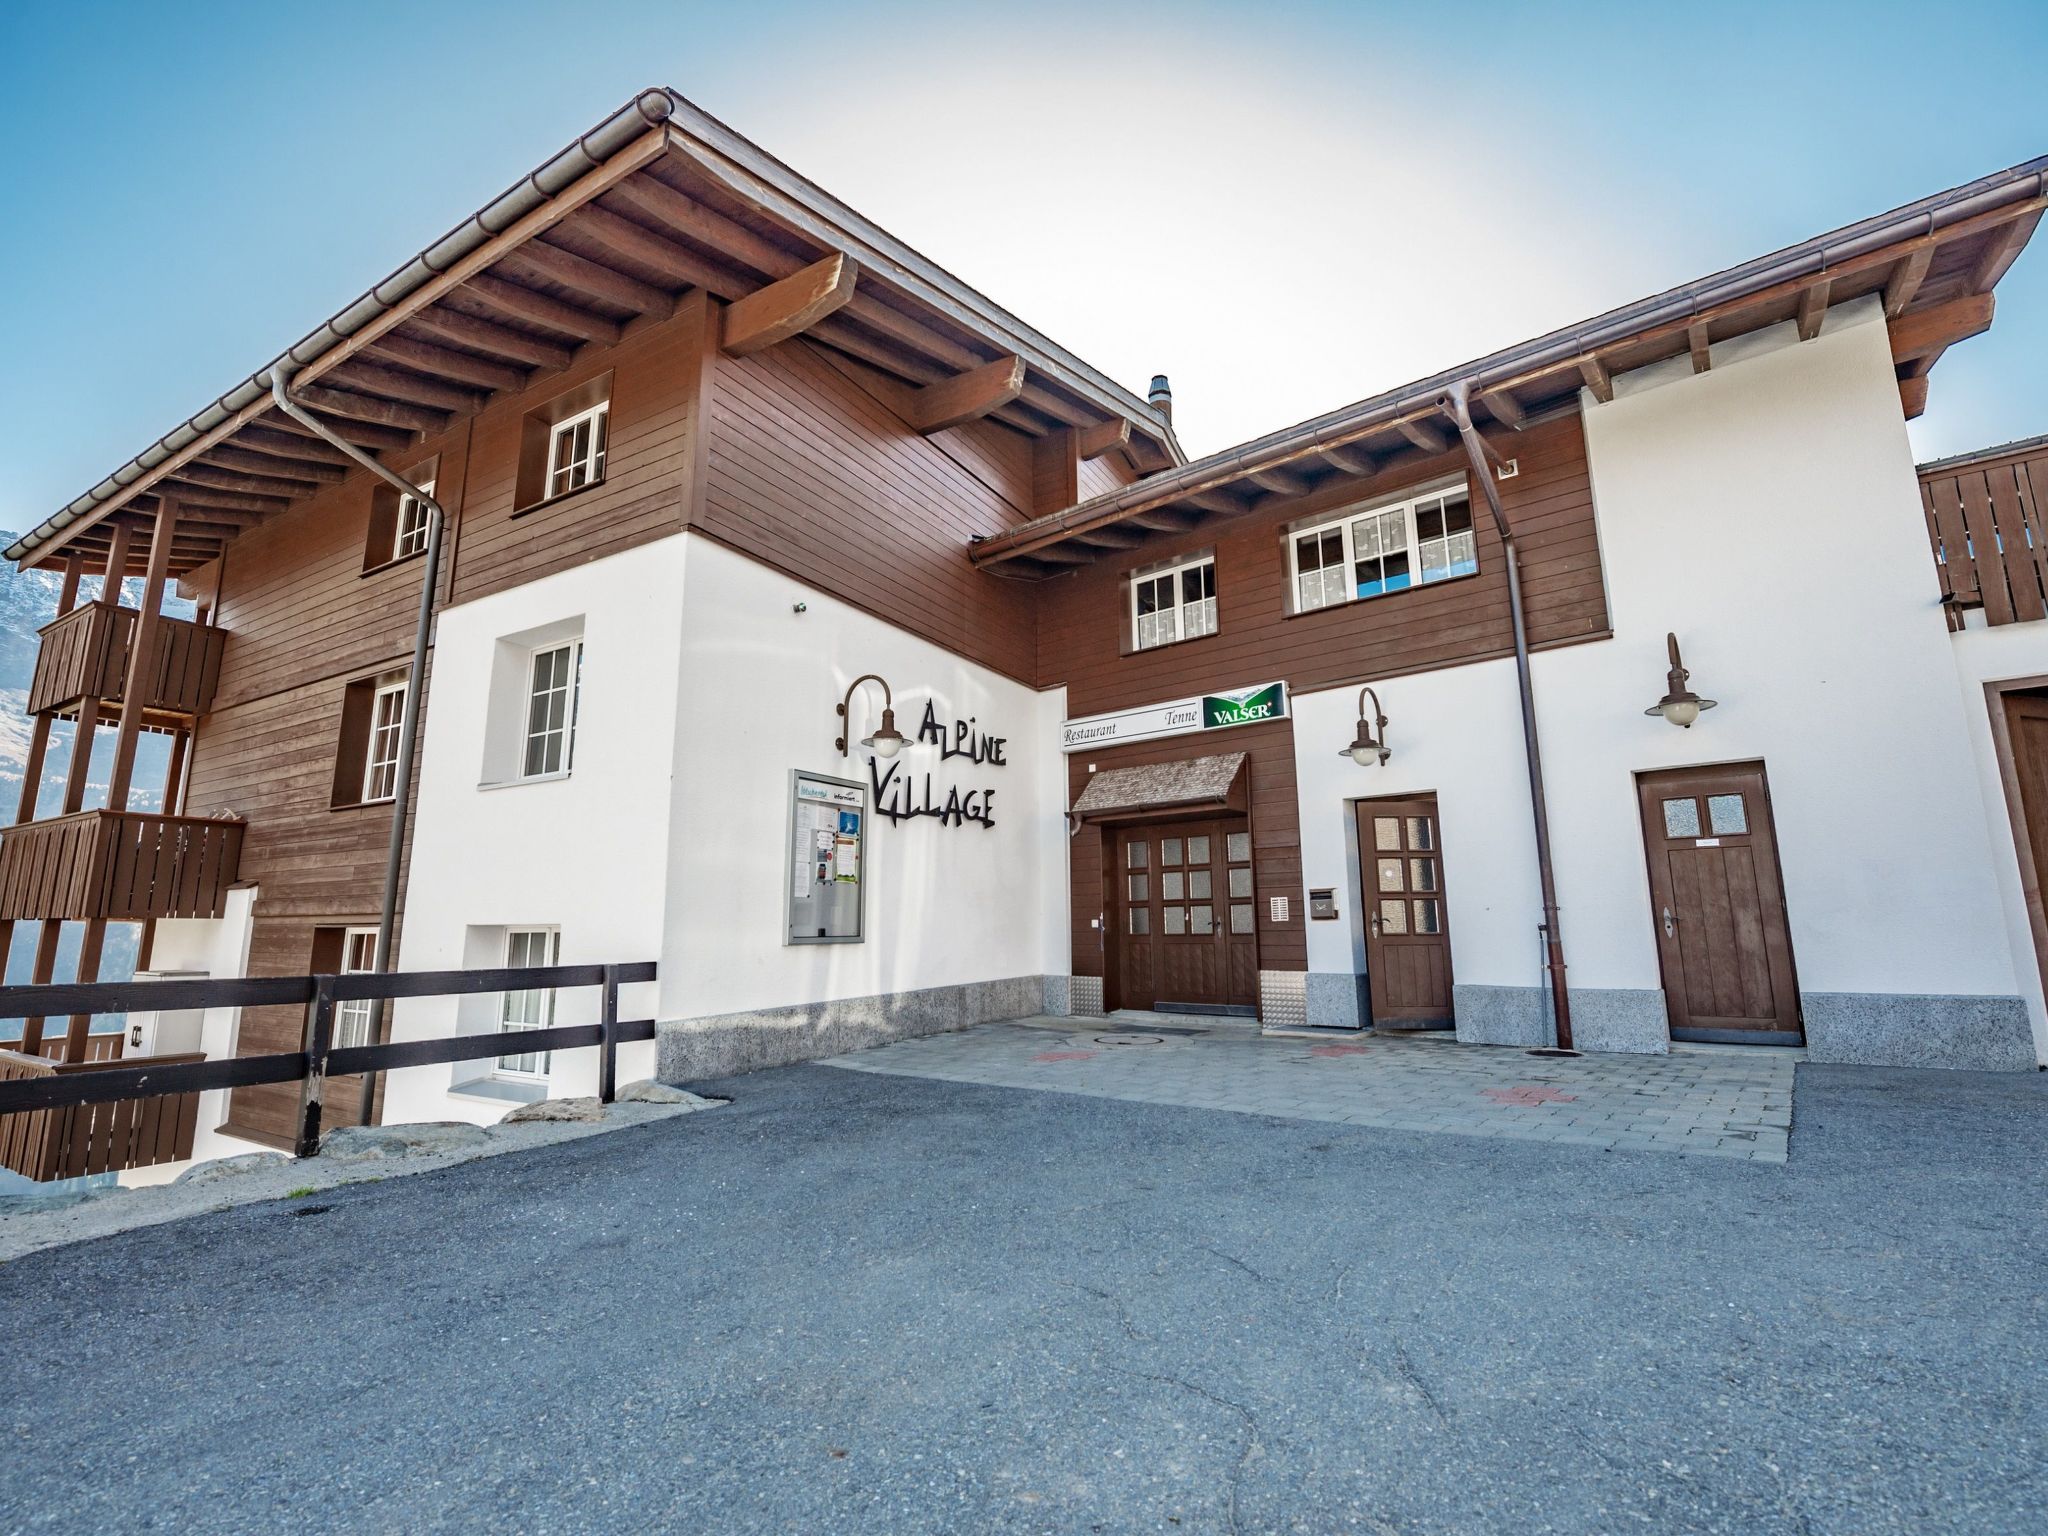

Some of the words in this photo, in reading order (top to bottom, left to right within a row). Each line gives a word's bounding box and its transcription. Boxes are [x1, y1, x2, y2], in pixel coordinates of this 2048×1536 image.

[1064, 723, 1116, 743] Restaurant
[1164, 710, 1197, 725] Tenne
[1213, 704, 1271, 724] VALSER
